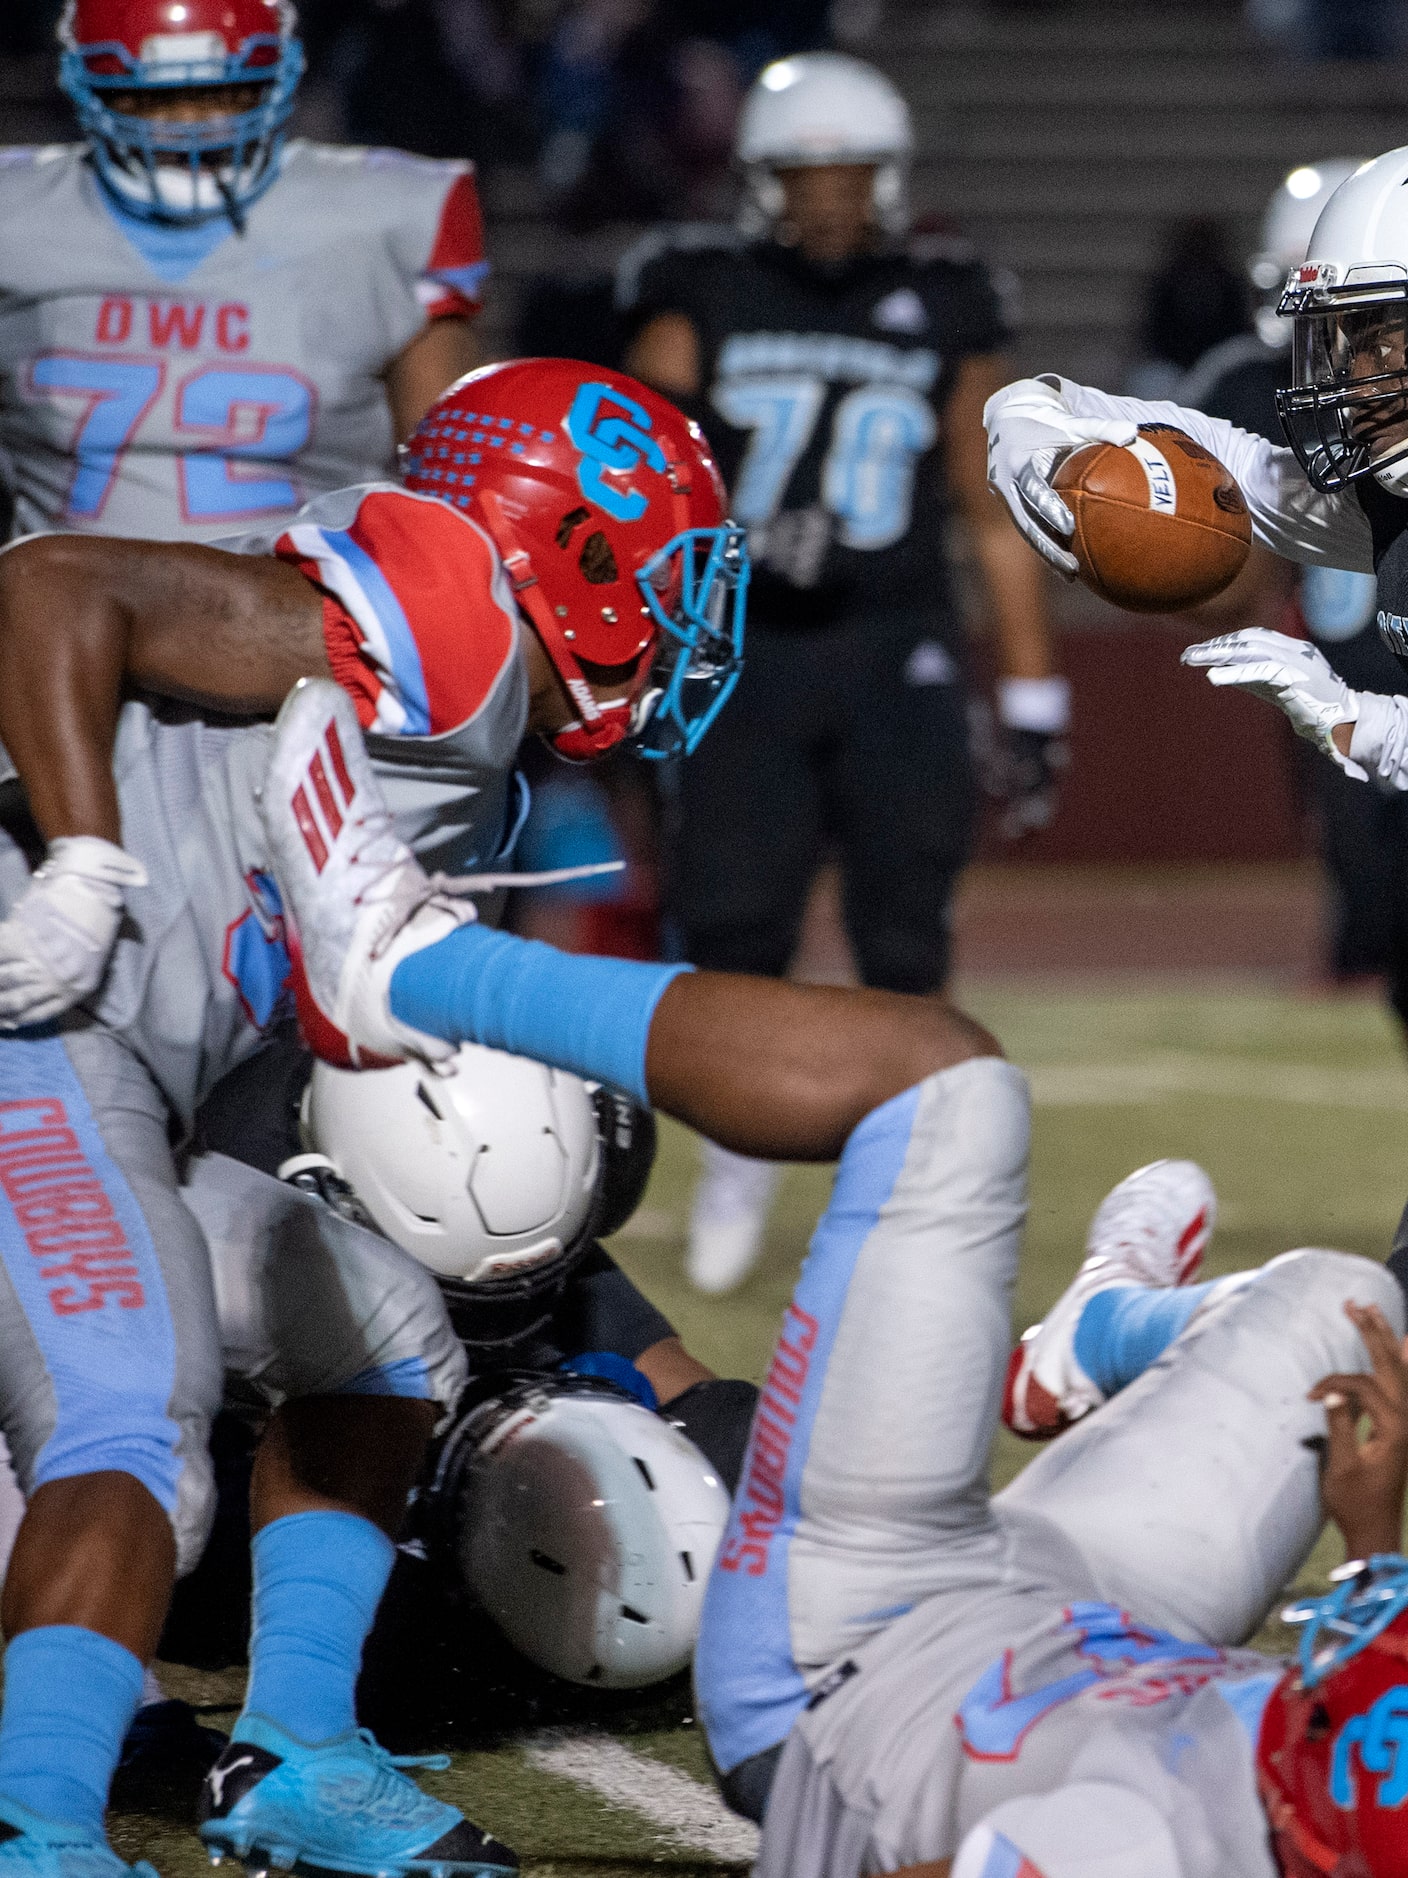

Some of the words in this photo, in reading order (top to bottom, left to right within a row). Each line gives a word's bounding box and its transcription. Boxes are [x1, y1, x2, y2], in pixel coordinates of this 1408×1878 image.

[95, 292, 250, 352] DWC
[23, 350, 318, 526] 72
[565, 678, 603, 721] ADAMS
[0, 1097, 146, 1316] COWBOYS
[719, 1301, 820, 1577] COWBOYS
